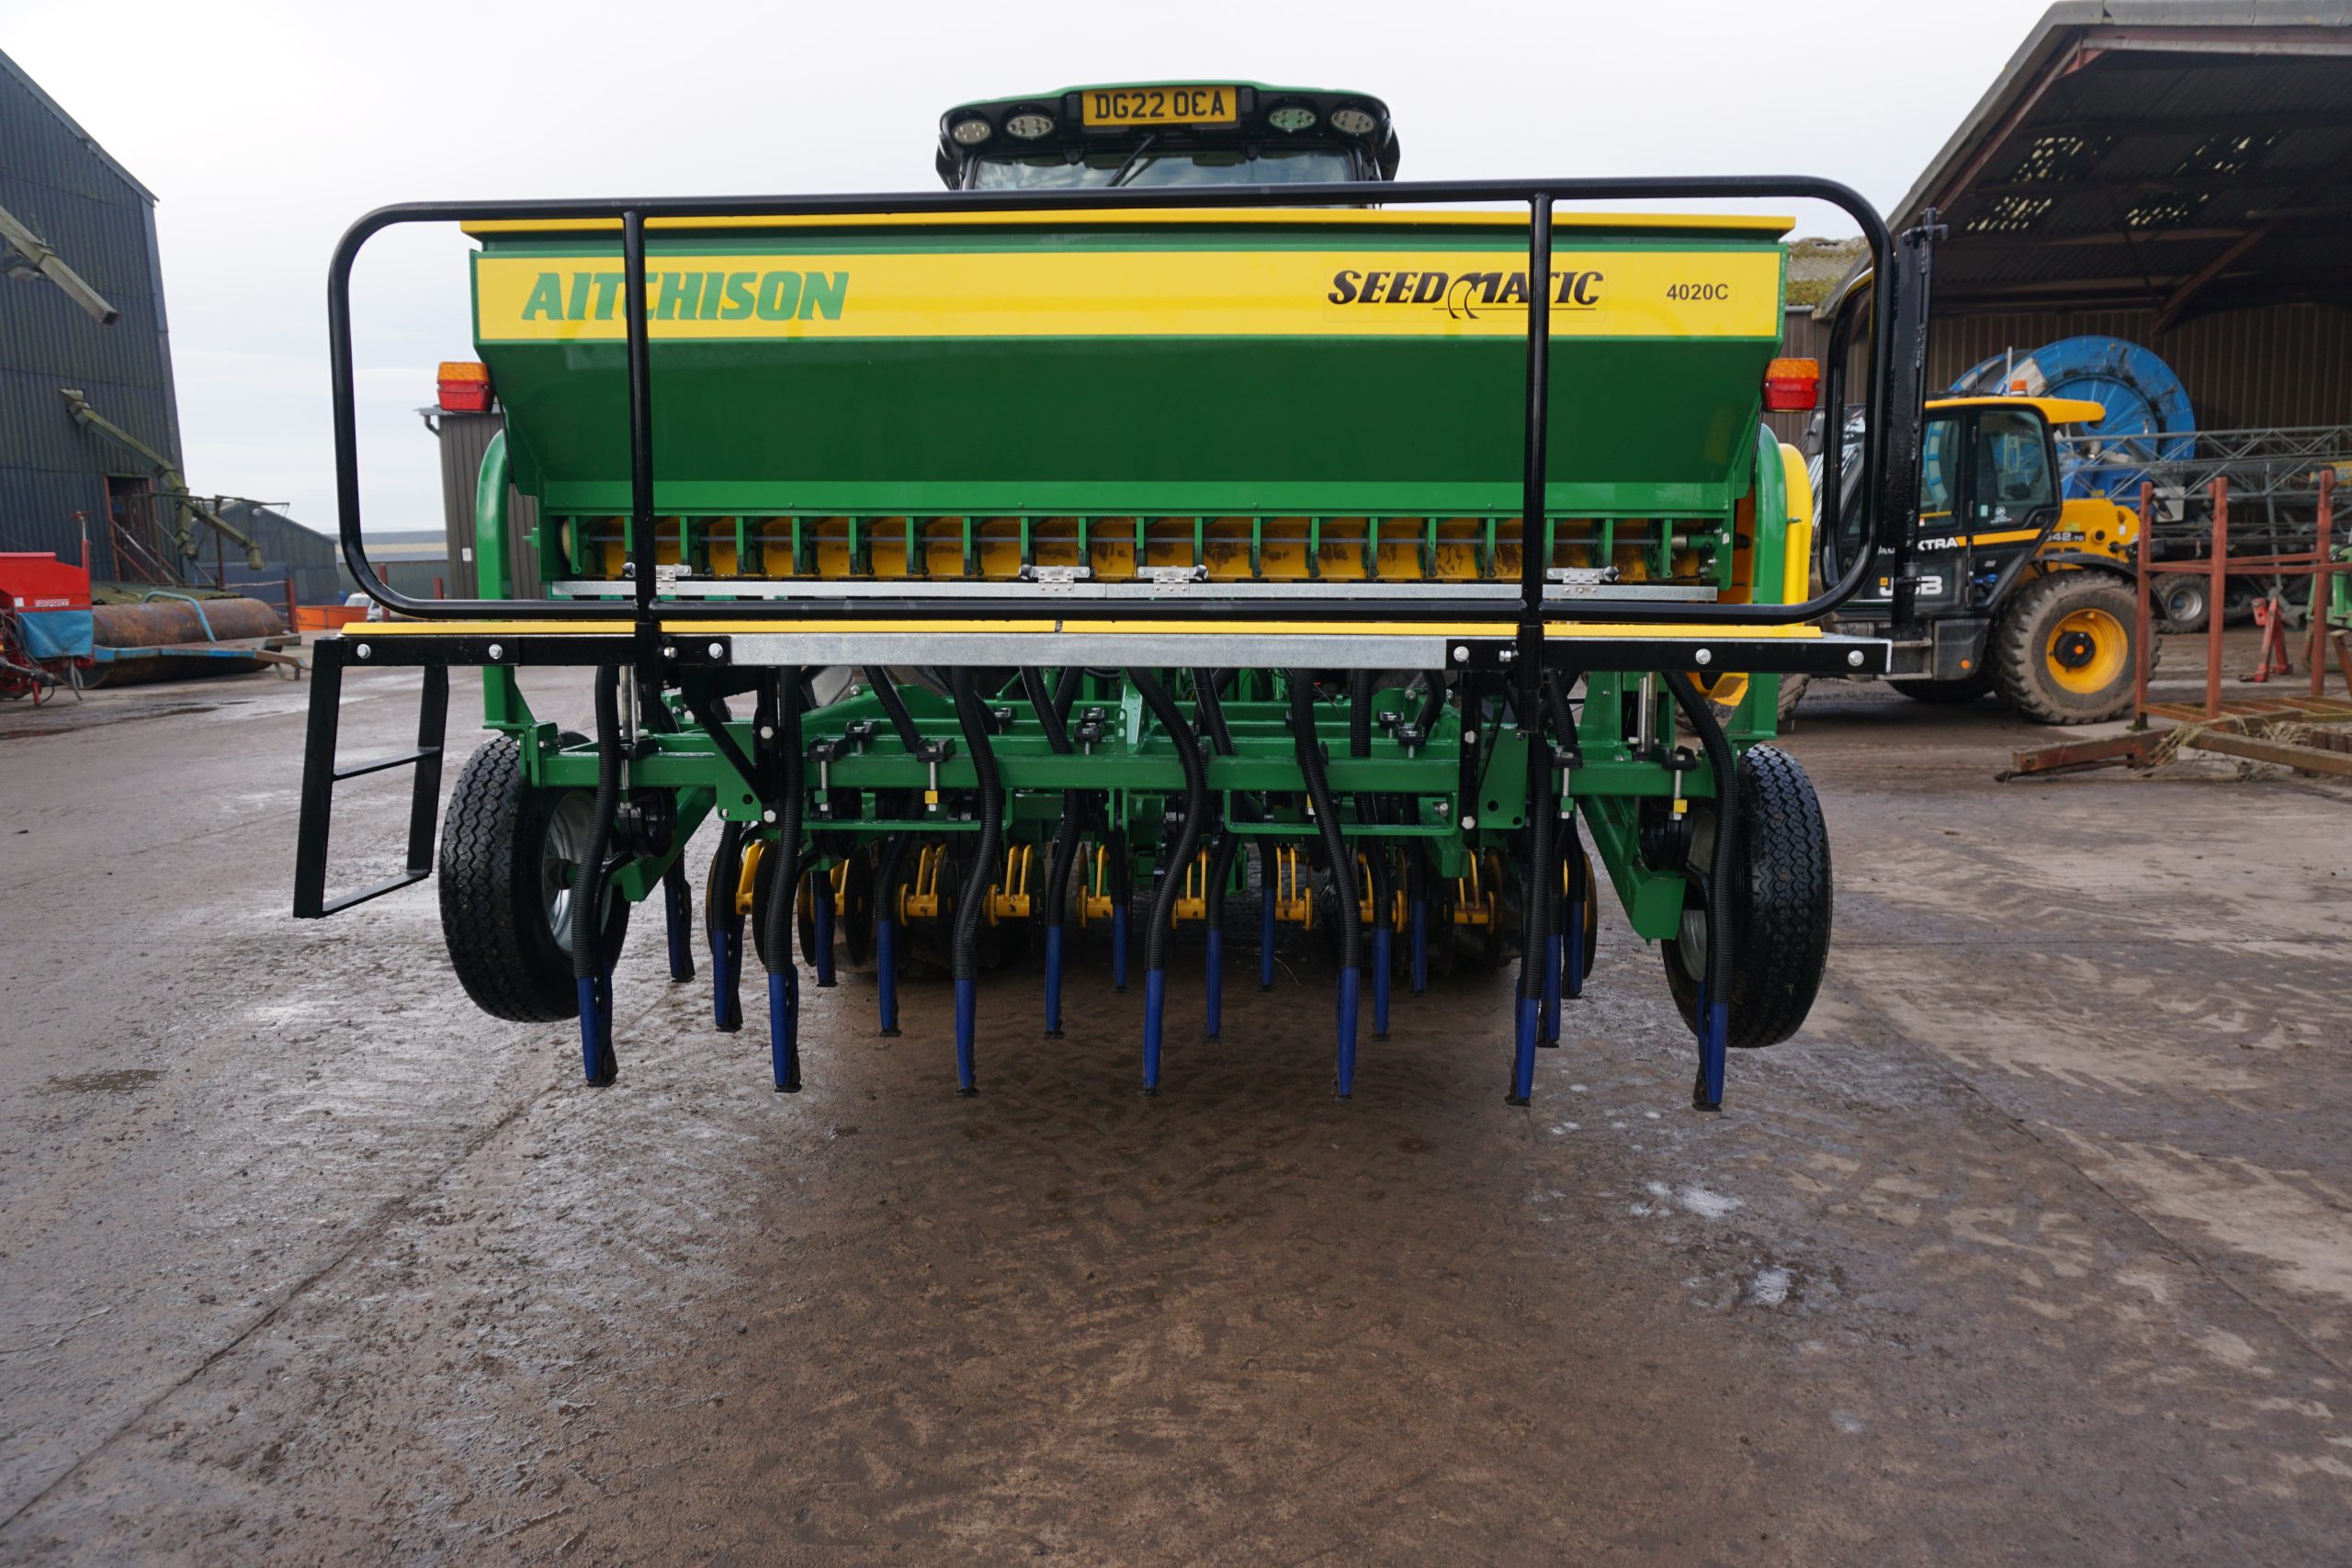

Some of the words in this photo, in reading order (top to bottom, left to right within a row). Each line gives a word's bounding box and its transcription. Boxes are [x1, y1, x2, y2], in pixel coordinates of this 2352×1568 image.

[1095, 93, 1165, 118] DG22
[1173, 91, 1225, 117] OEA
[1667, 283, 1729, 300] 4020C
[1880, 576, 1942, 596] JB
